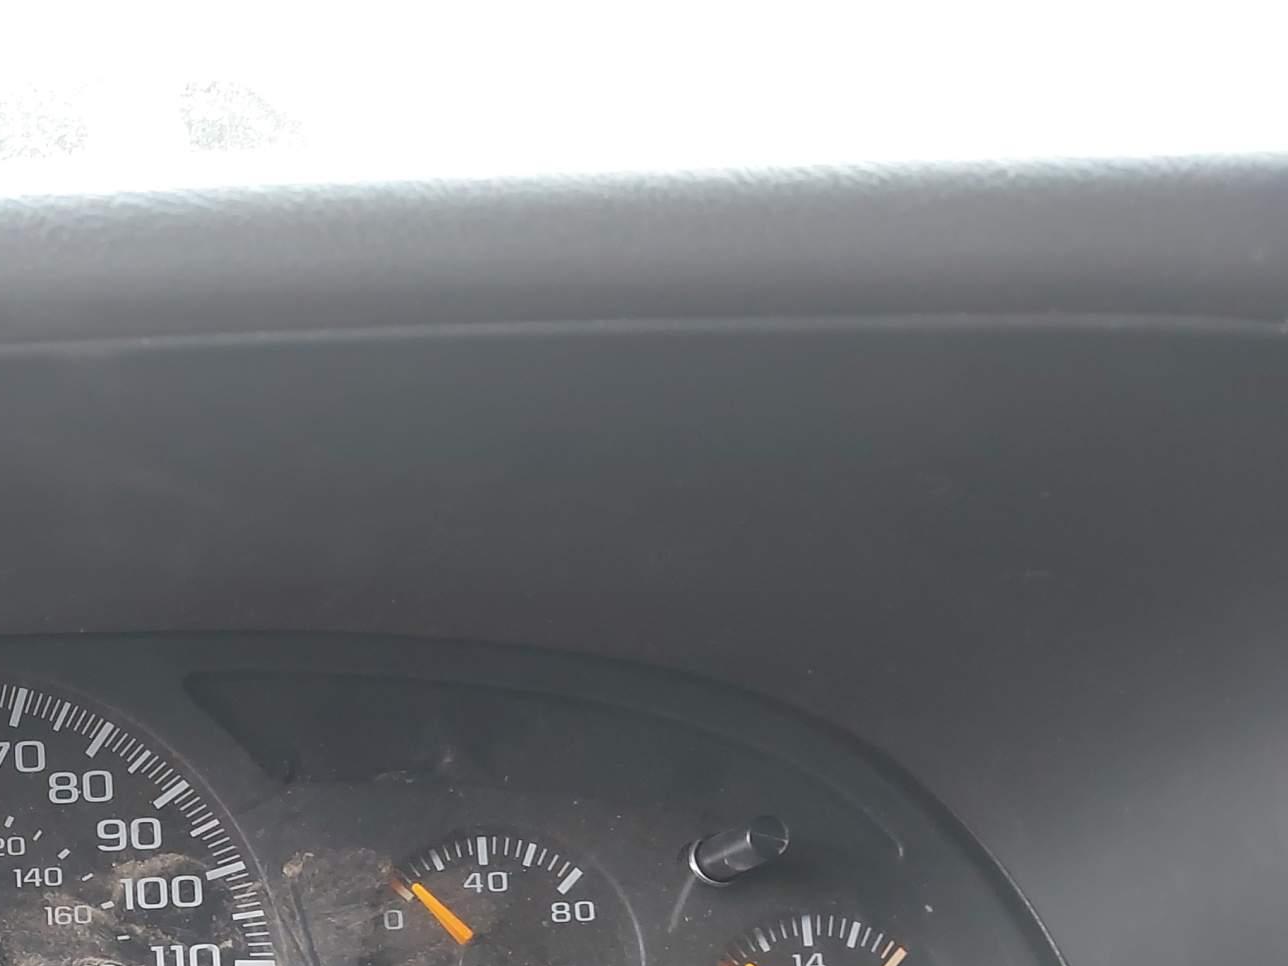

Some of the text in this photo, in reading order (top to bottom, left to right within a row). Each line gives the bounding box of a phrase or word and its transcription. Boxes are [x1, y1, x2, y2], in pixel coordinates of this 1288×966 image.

[49, 771, 112, 803] 80
[97, 818, 161, 850] 90
[14, 868, 62, 887] 140
[464, 872, 507, 892] 40
[120, 876, 202, 909] 100
[45, 905, 94, 925] 160
[385, 910, 403, 929] 0
[552, 902, 594, 922] 80
